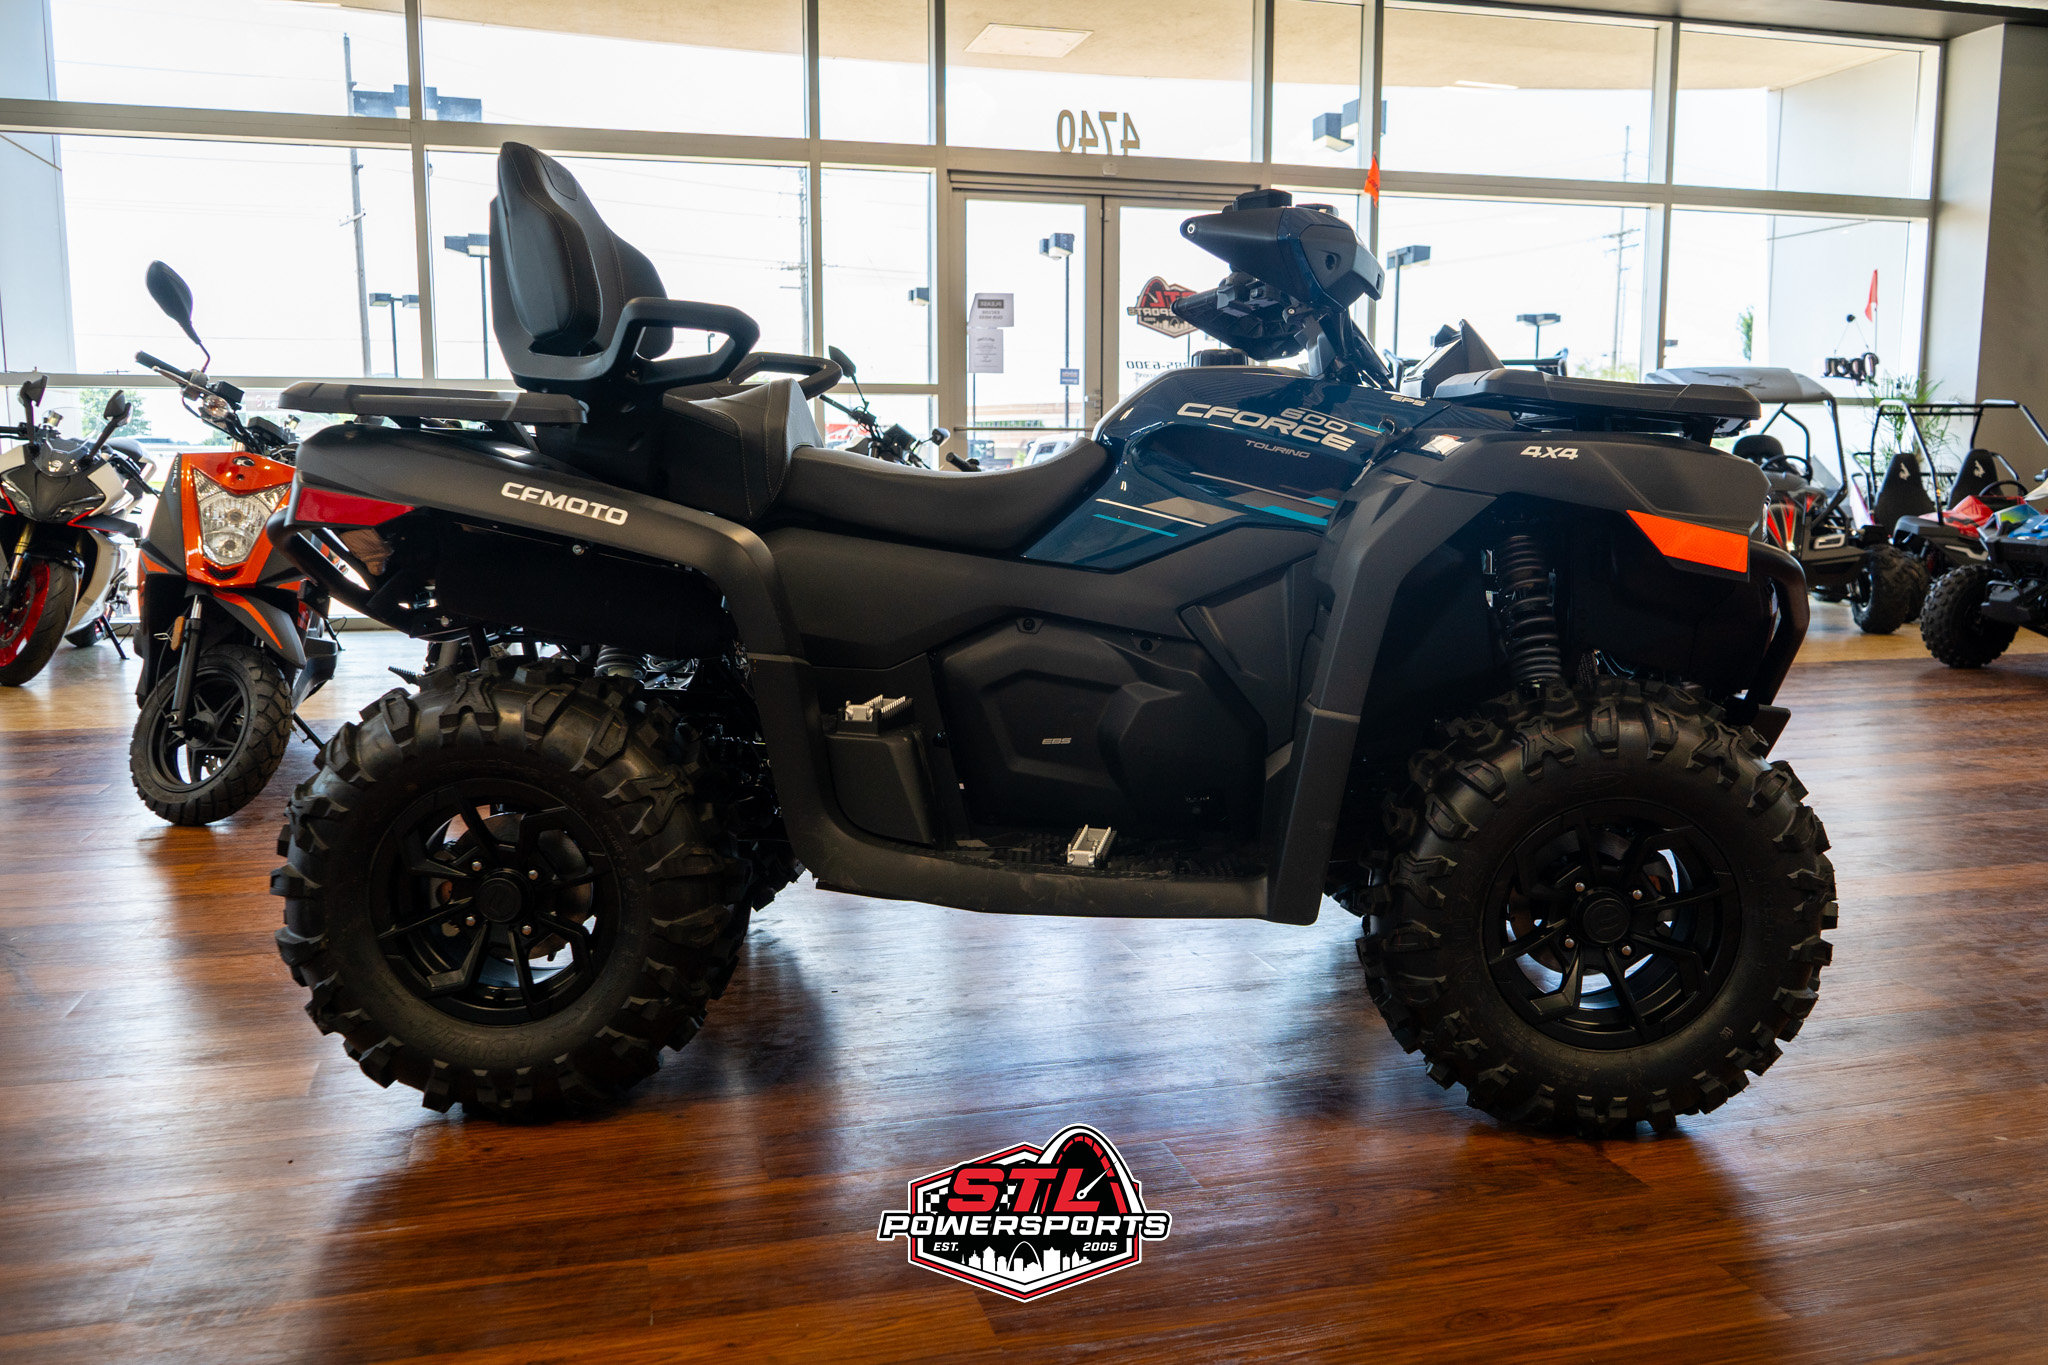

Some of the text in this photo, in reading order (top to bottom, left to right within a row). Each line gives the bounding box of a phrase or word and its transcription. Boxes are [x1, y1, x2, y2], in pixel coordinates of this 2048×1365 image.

[1390, 394, 1427, 407] EPS
[1176, 402, 1357, 452] CFORCE
[1280, 407, 1349, 433] 600
[1245, 439, 1311, 459] TOURING
[1520, 445, 1579, 460] 4X4
[501, 481, 629, 526] CFMOTO
